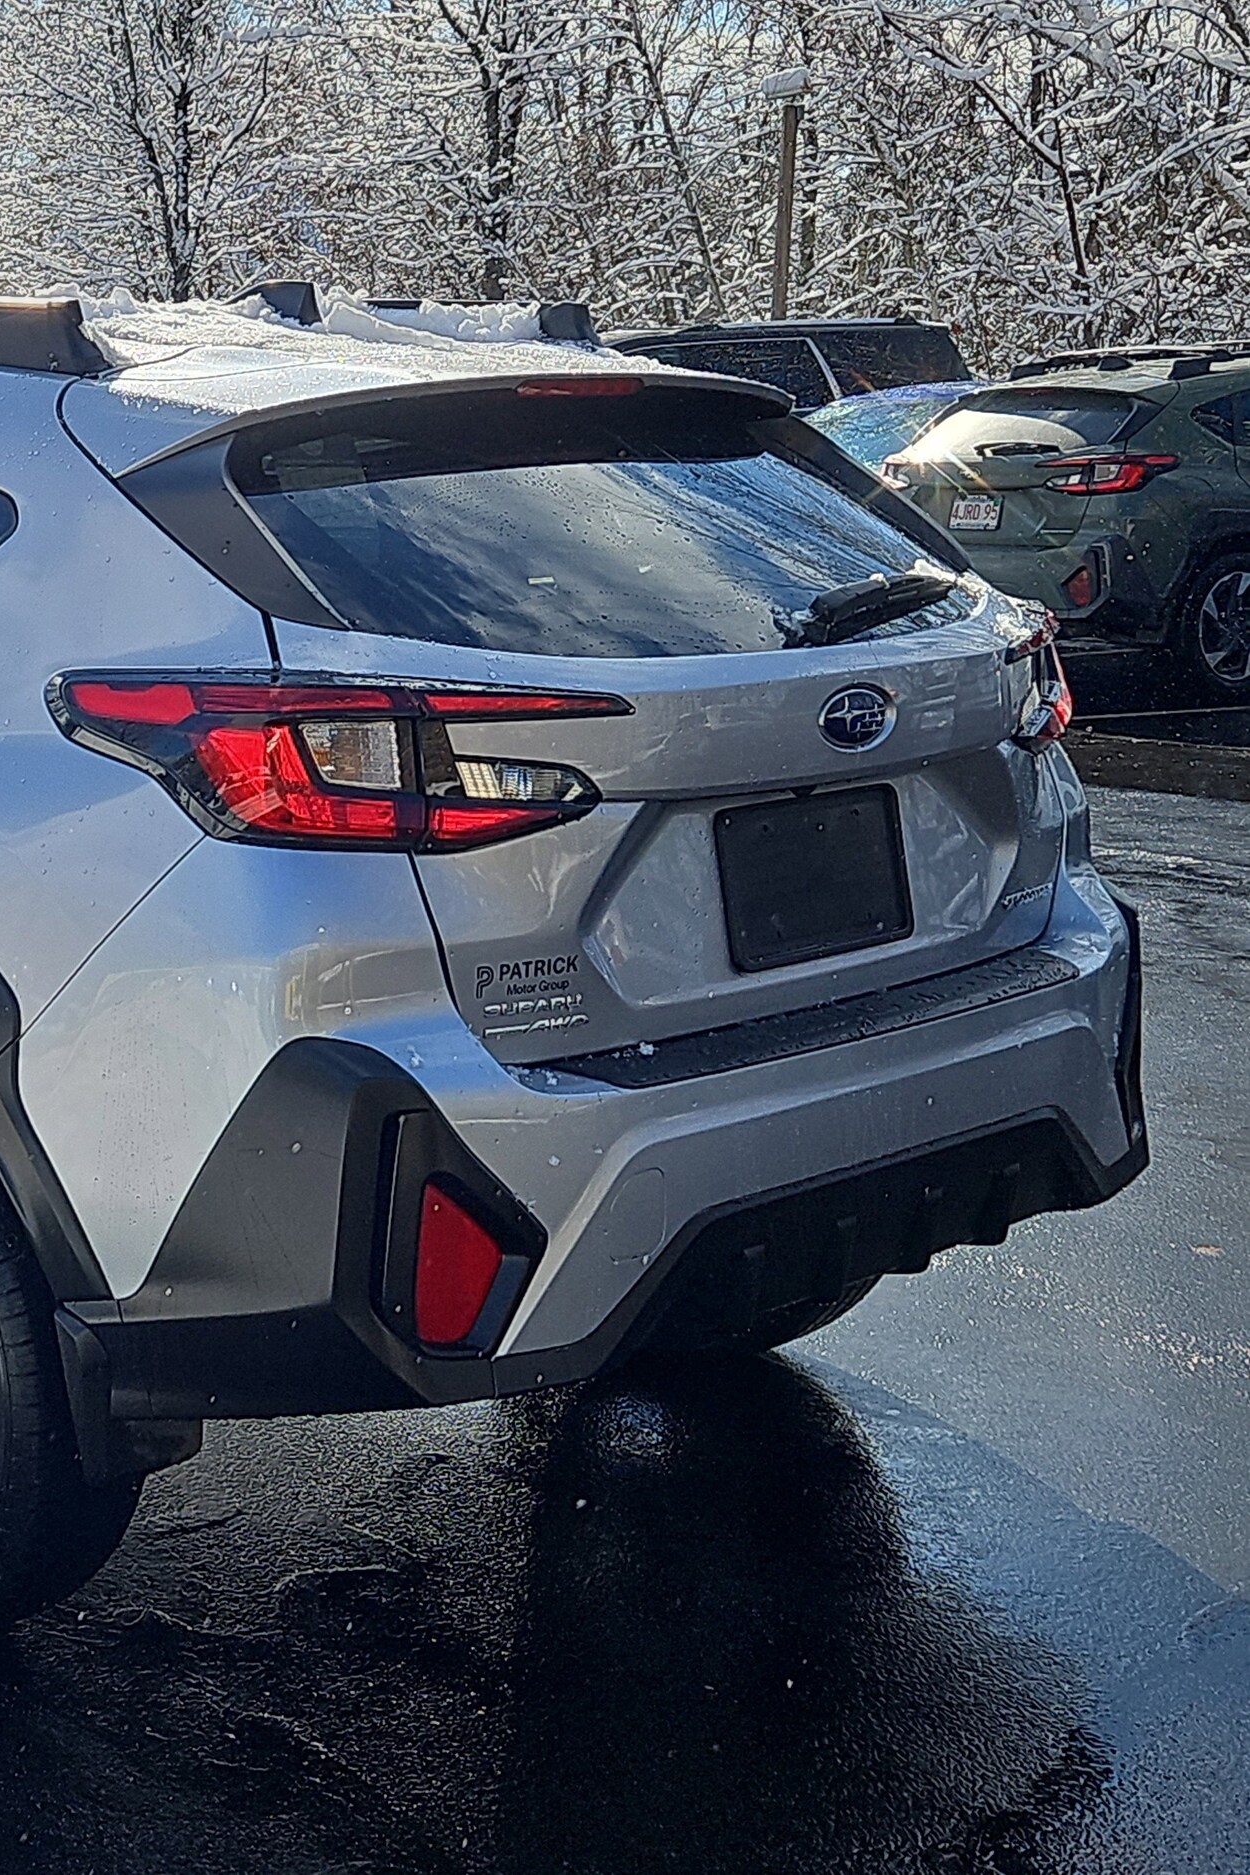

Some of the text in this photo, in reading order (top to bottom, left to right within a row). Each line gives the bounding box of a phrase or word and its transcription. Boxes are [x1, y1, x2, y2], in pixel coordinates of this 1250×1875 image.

[951, 503, 998, 520] 4JRD 95
[499, 954, 579, 982] PATRICK
[506, 979, 570, 996] Motor Group
[483, 993, 582, 1018] SUBARU
